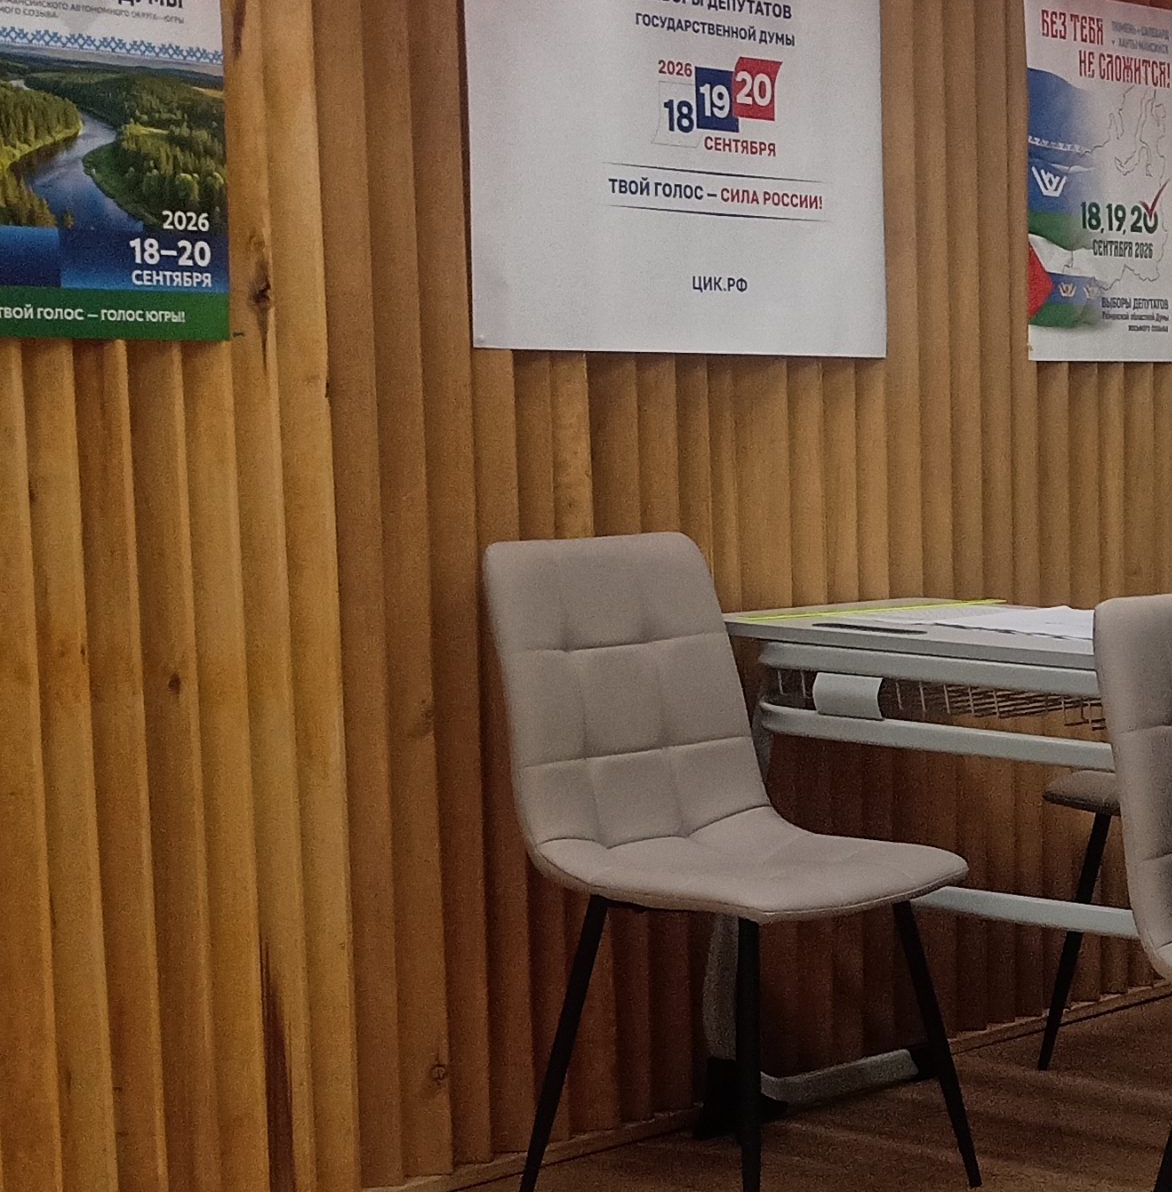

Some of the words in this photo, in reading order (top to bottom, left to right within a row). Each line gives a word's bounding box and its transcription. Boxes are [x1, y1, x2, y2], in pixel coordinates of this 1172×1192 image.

[635, 12, 757, 42] ГОСУДАРСТВЕННОЙ
[758, 31, 796, 47] ДУМЫ
[1041, 9, 1067, 40] БЕЗ
[1070, 13, 1104, 45] ТЕБЯ
[658, 59, 693, 78] 2026
[1079, 49, 1095, 79] НЕ
[1099, 52, 1171, 89] СЛОЖИТСЯ!
[663, 99, 695, 134] 18
[699, 83, 731, 119] 19
[735, 71, 772, 107] 20
[704, 136, 777, 157] СЕНТЯБРЯ
[608, 177, 651, 197] ТВОЙ
[654, 182, 704, 201] ГОЛОС
[720, 187, 760, 206] СИЛА
[763, 191, 823, 210] РОССИИ!
[161, 210, 210, 232] 2026
[1092, 239, 1133, 258] СЕНТЯБРЯ
[1134, 242, 1154, 259] 2026
[131, 270, 213, 288] СЕНТЯБРЯ
[692, 275, 748, 293] ЦИК.РФ
[1101, 296, 1132, 309] ВЫБОРЫ
[1133, 297, 1169, 310] ДЕПУТАТОВ
[37, 307, 85, 321] ГОЛОС
[101, 309, 145, 322] ГОЛОС
[146, 310, 186, 323] ЮГРЫ!
